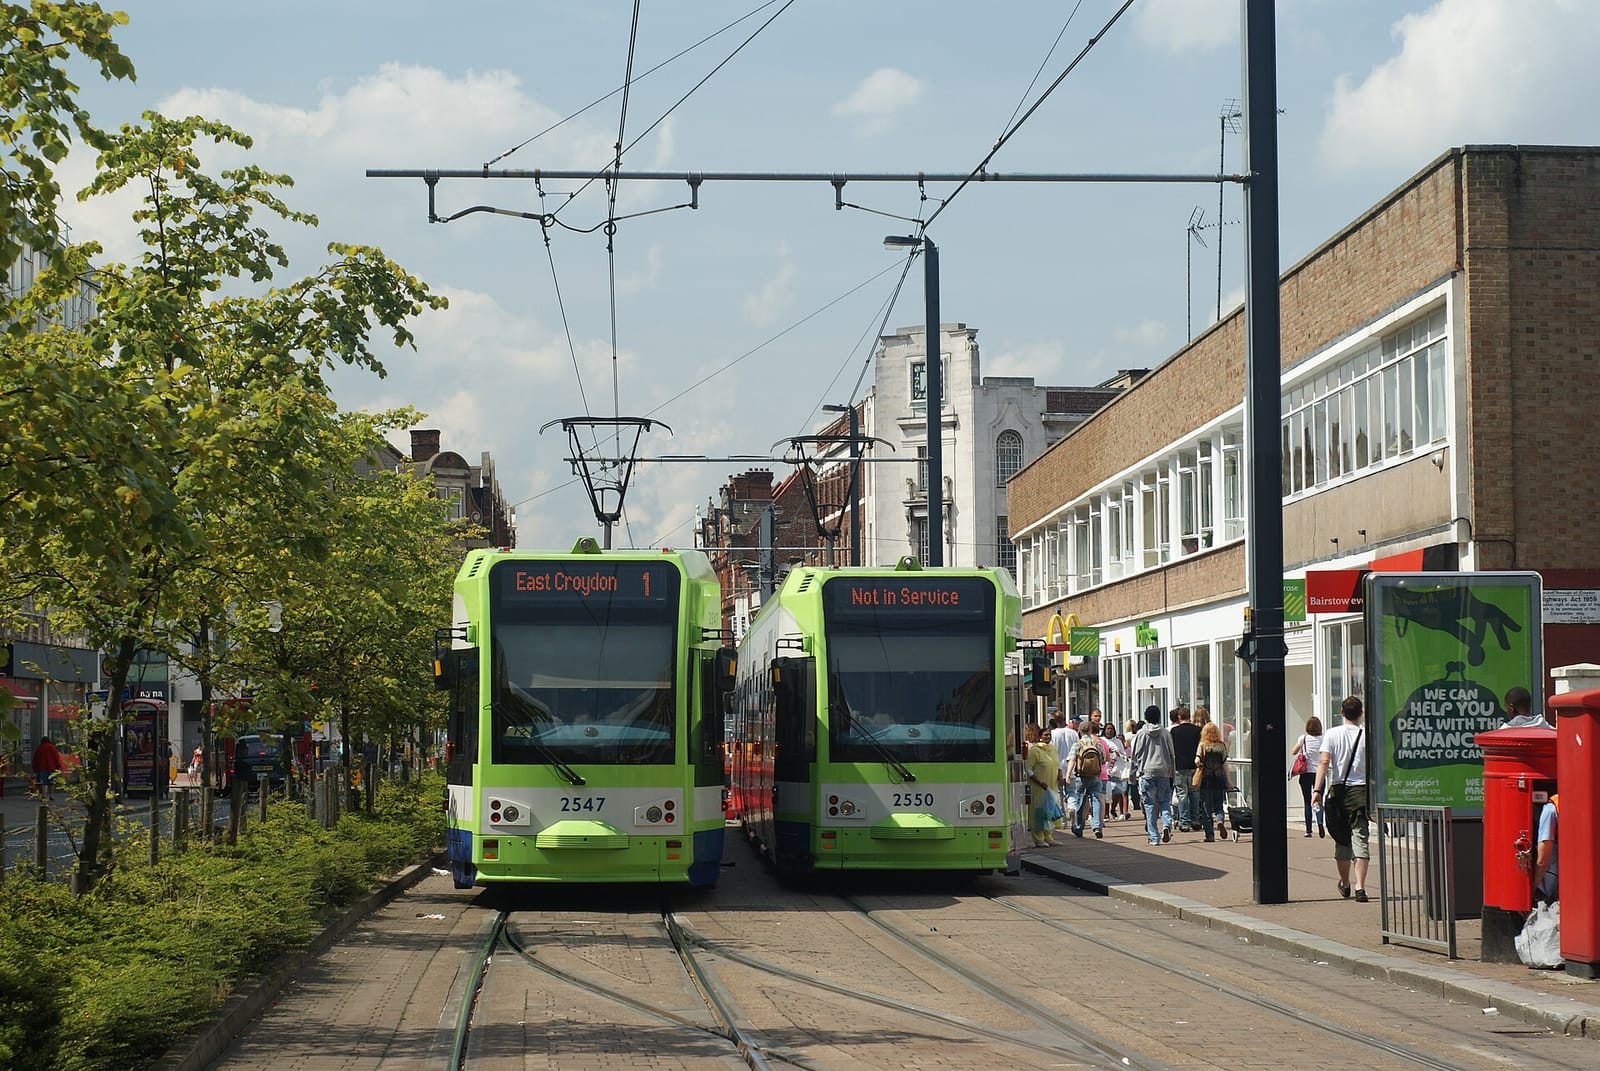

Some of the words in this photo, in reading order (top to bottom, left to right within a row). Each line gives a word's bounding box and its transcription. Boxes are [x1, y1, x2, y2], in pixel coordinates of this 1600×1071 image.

[515, 571, 551, 591] East
[554, 571, 617, 597] Croydon
[642, 571, 651, 597] 1
[851, 586, 879, 605] Not
[883, 588, 897, 605] in
[900, 586, 960, 605] Service
[1309, 596, 1350, 606] Bairstow
[1424, 688, 1447, 700] WE
[1449, 688, 1478, 700] CAN
[1410, 701, 1453, 716] HELP
[1455, 701, 1494, 716] YOU
[1397, 717, 1433, 731] DEAL
[1436, 718, 1474, 730] WITH
[1476, 717, 1504, 730] THE
[1398, 749, 1444, 759] IMPACT
[1444, 749, 1459, 759] OF
[1387, 778, 1403, 787] For
[1405, 778, 1440, 788] support
[1465, 778, 1480, 786] WE
[560, 797, 606, 812] 2547
[892, 793, 934, 807] 2550
